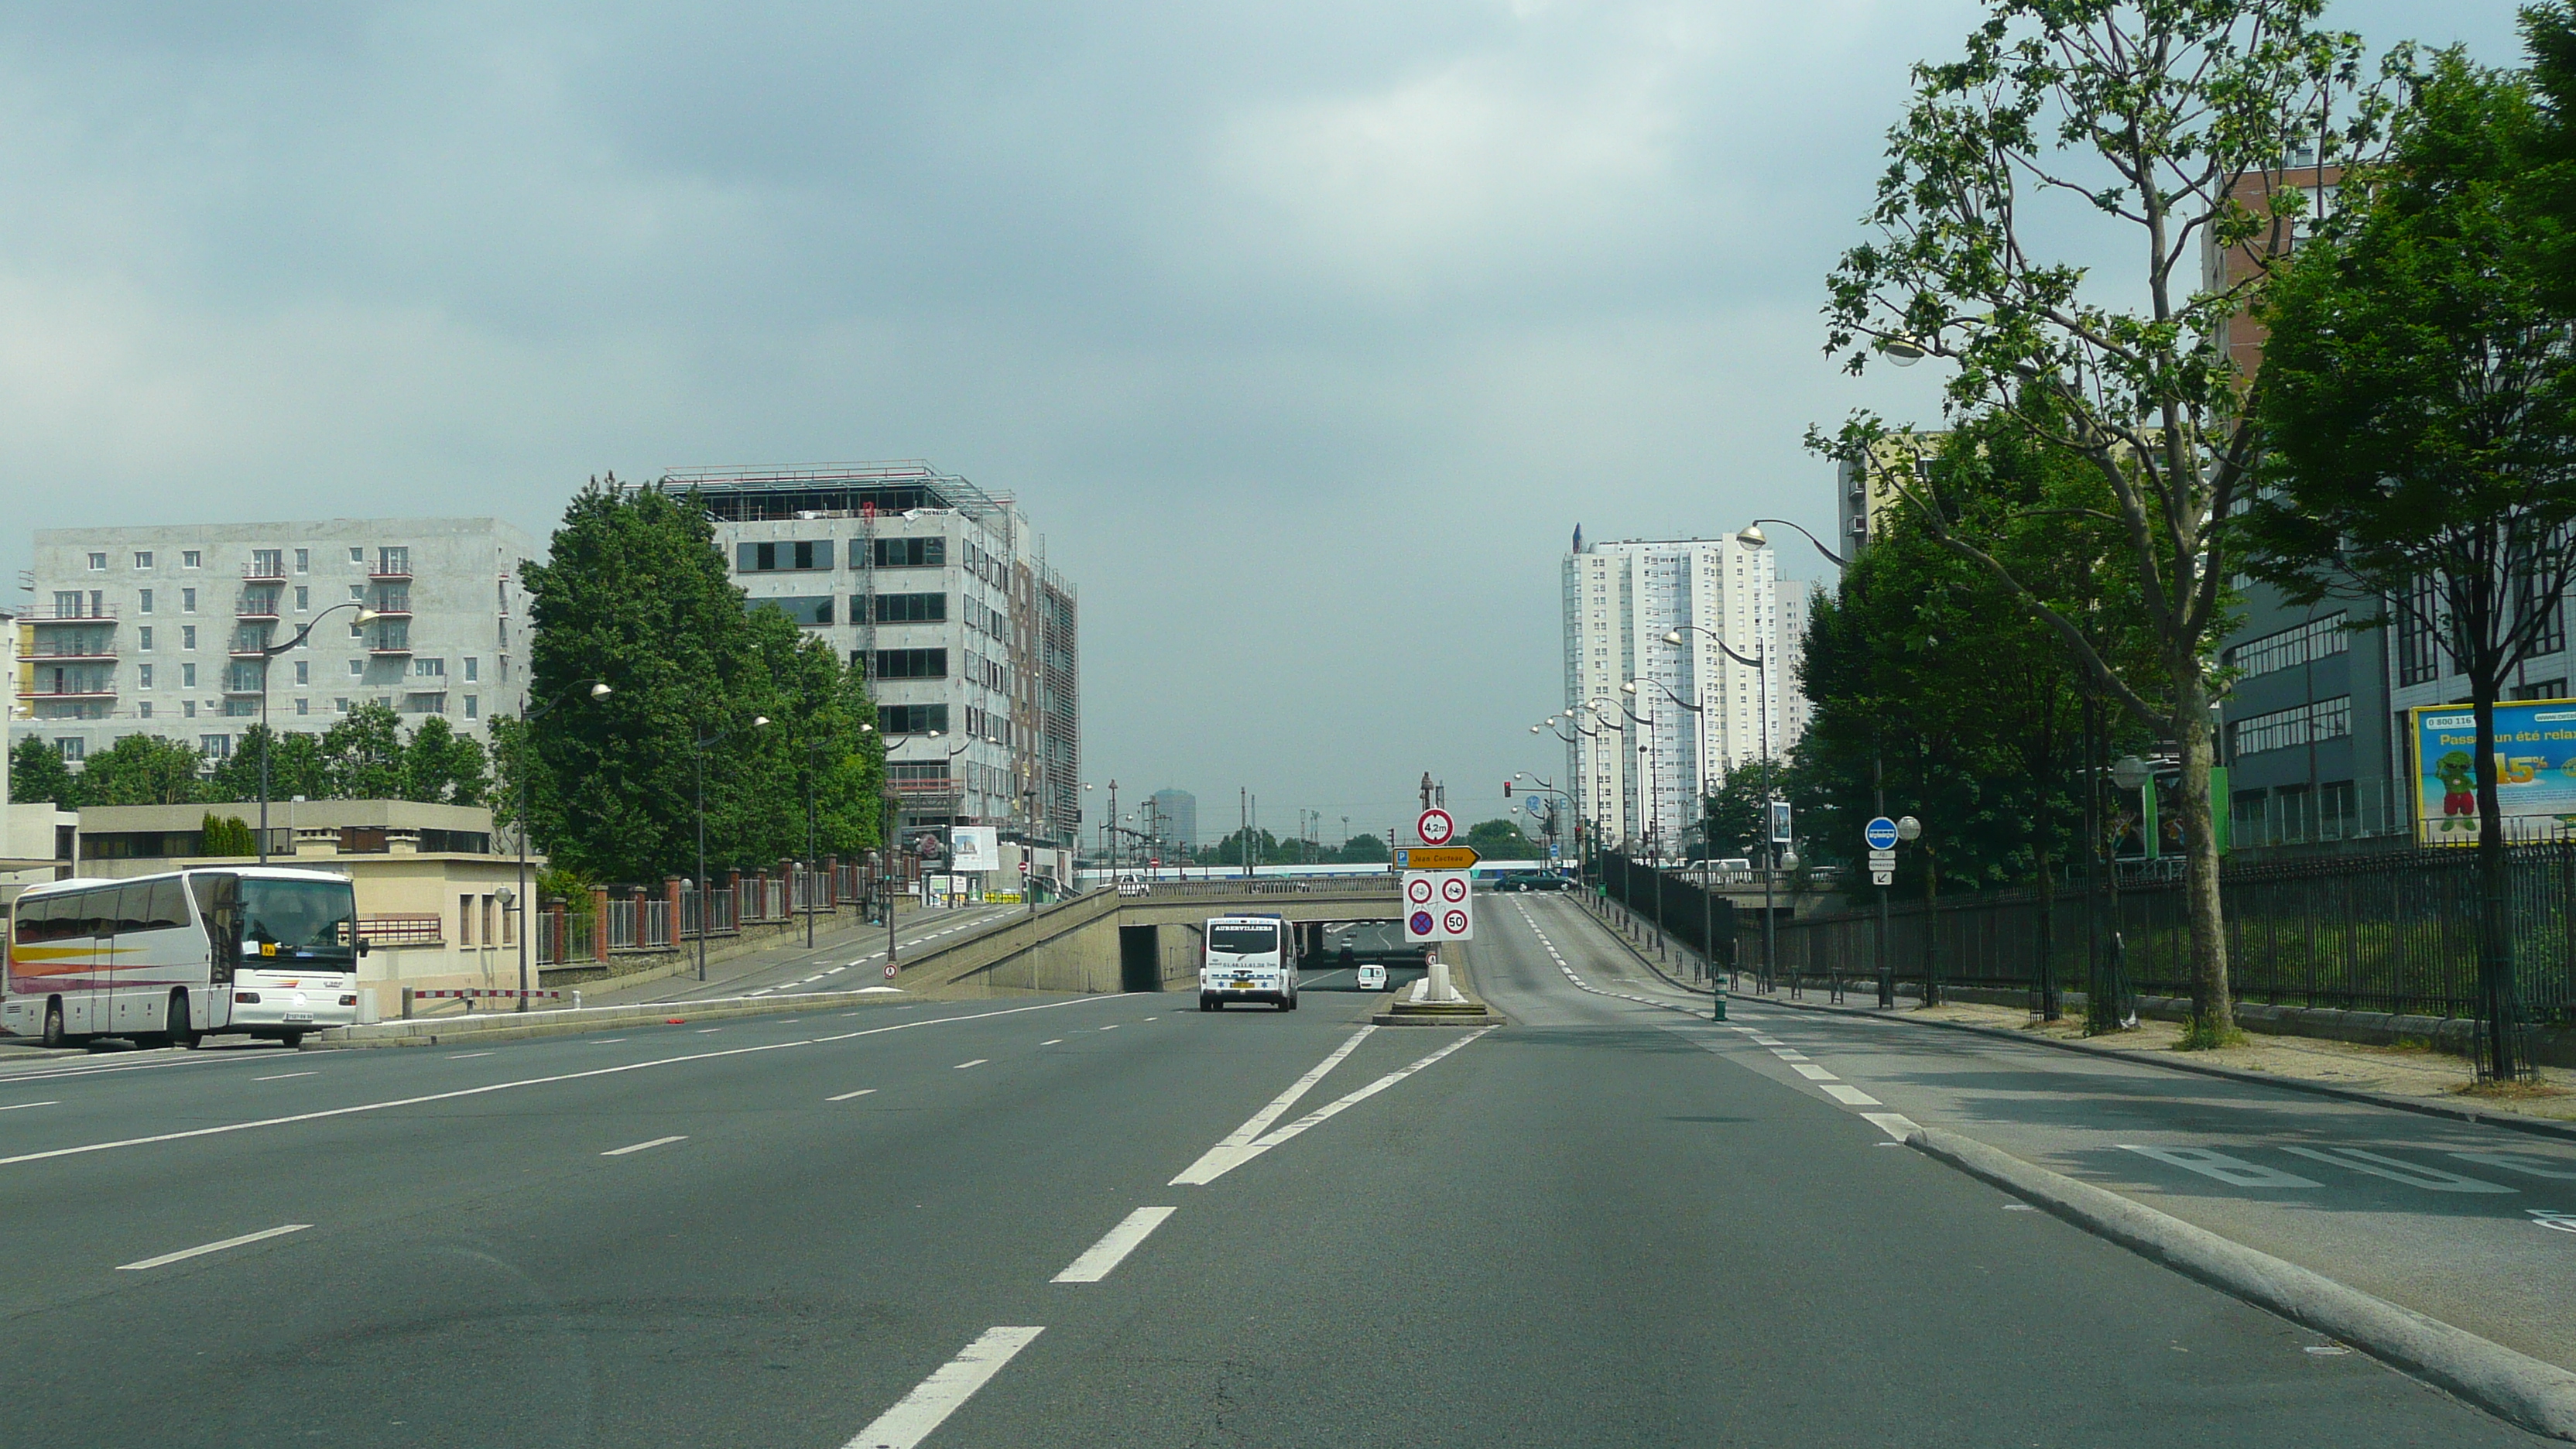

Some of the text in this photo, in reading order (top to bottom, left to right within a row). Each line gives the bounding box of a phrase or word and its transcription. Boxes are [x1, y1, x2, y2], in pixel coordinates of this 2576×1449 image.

[2437, 718, 2453, 726] 800
[2440, 734, 2477, 745] Pass
[2494, 734, 2512, 743] un
[2516, 730, 2540, 742] été
[1424, 822, 1447, 833] 4,2m
[1449, 916, 1463, 927] 50
